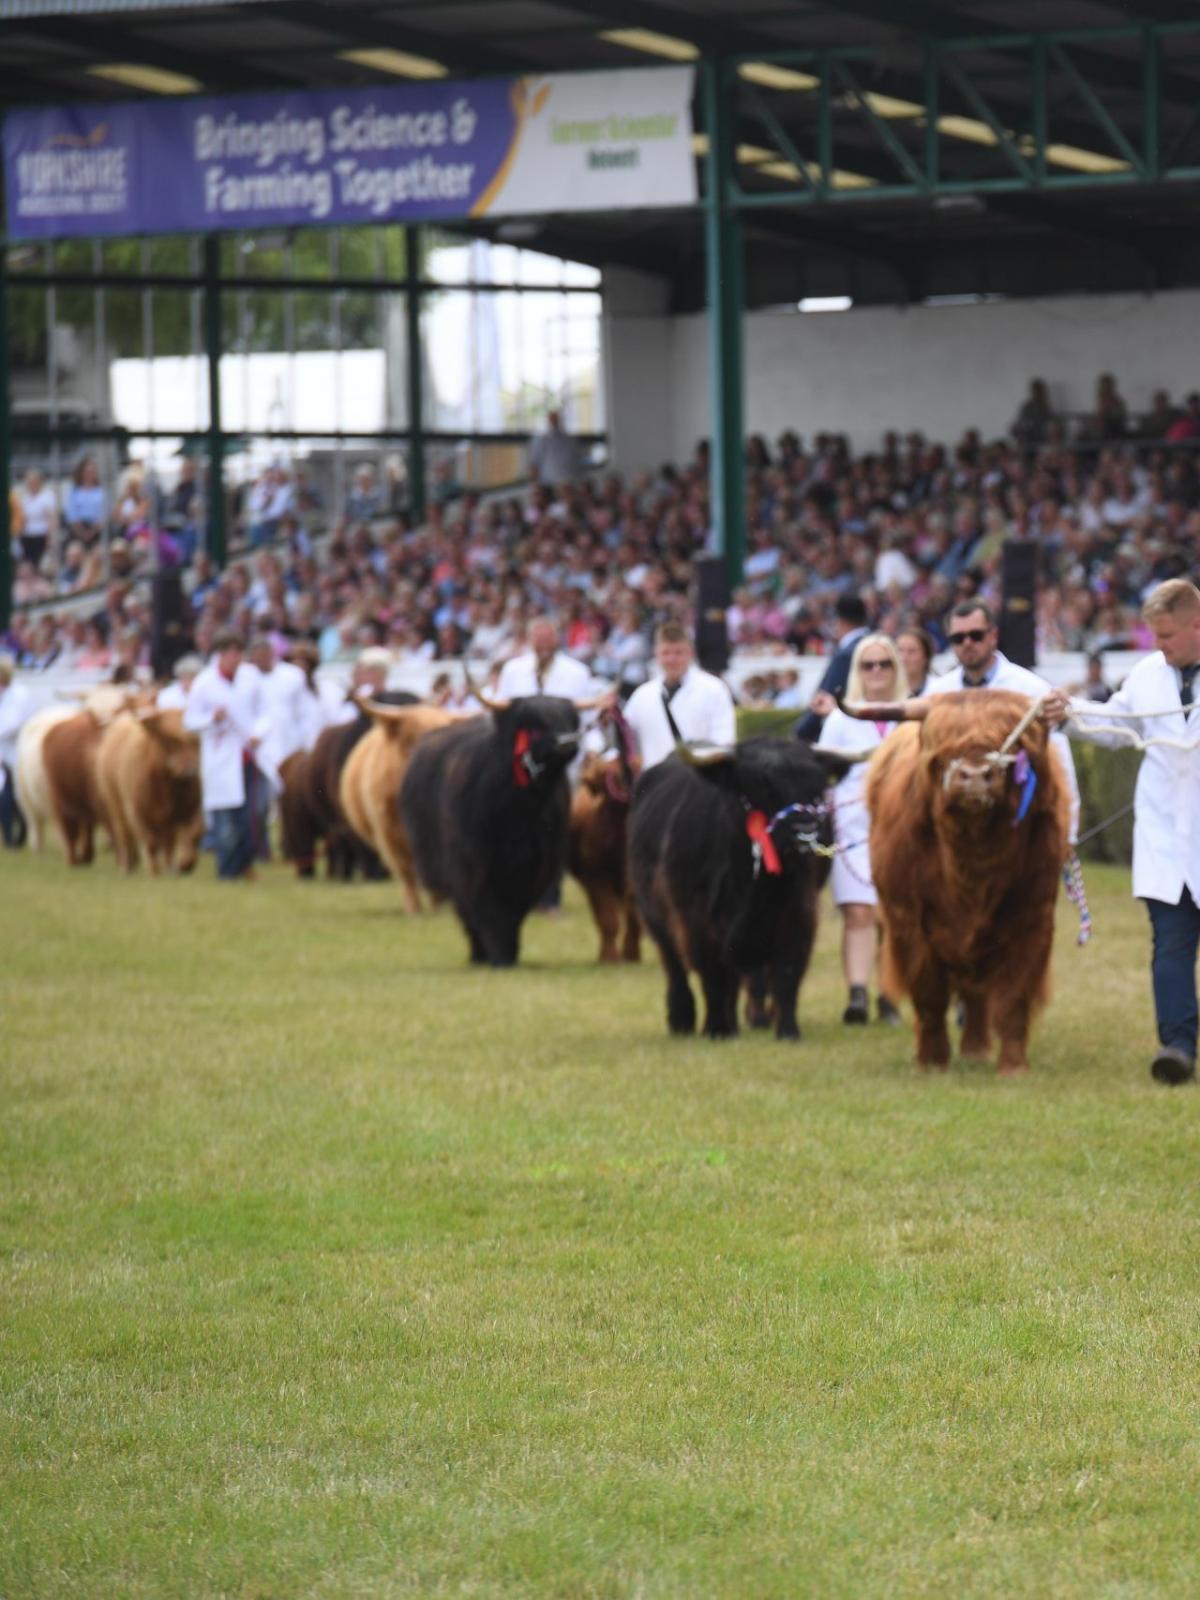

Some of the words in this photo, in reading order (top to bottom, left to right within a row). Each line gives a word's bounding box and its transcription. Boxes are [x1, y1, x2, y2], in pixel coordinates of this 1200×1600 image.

[195, 112, 325, 168] Bringing
[330, 104, 448, 152] Science
[452, 98, 477, 145] &
[204, 162, 332, 218] Farming
[333, 155, 475, 215] Together
